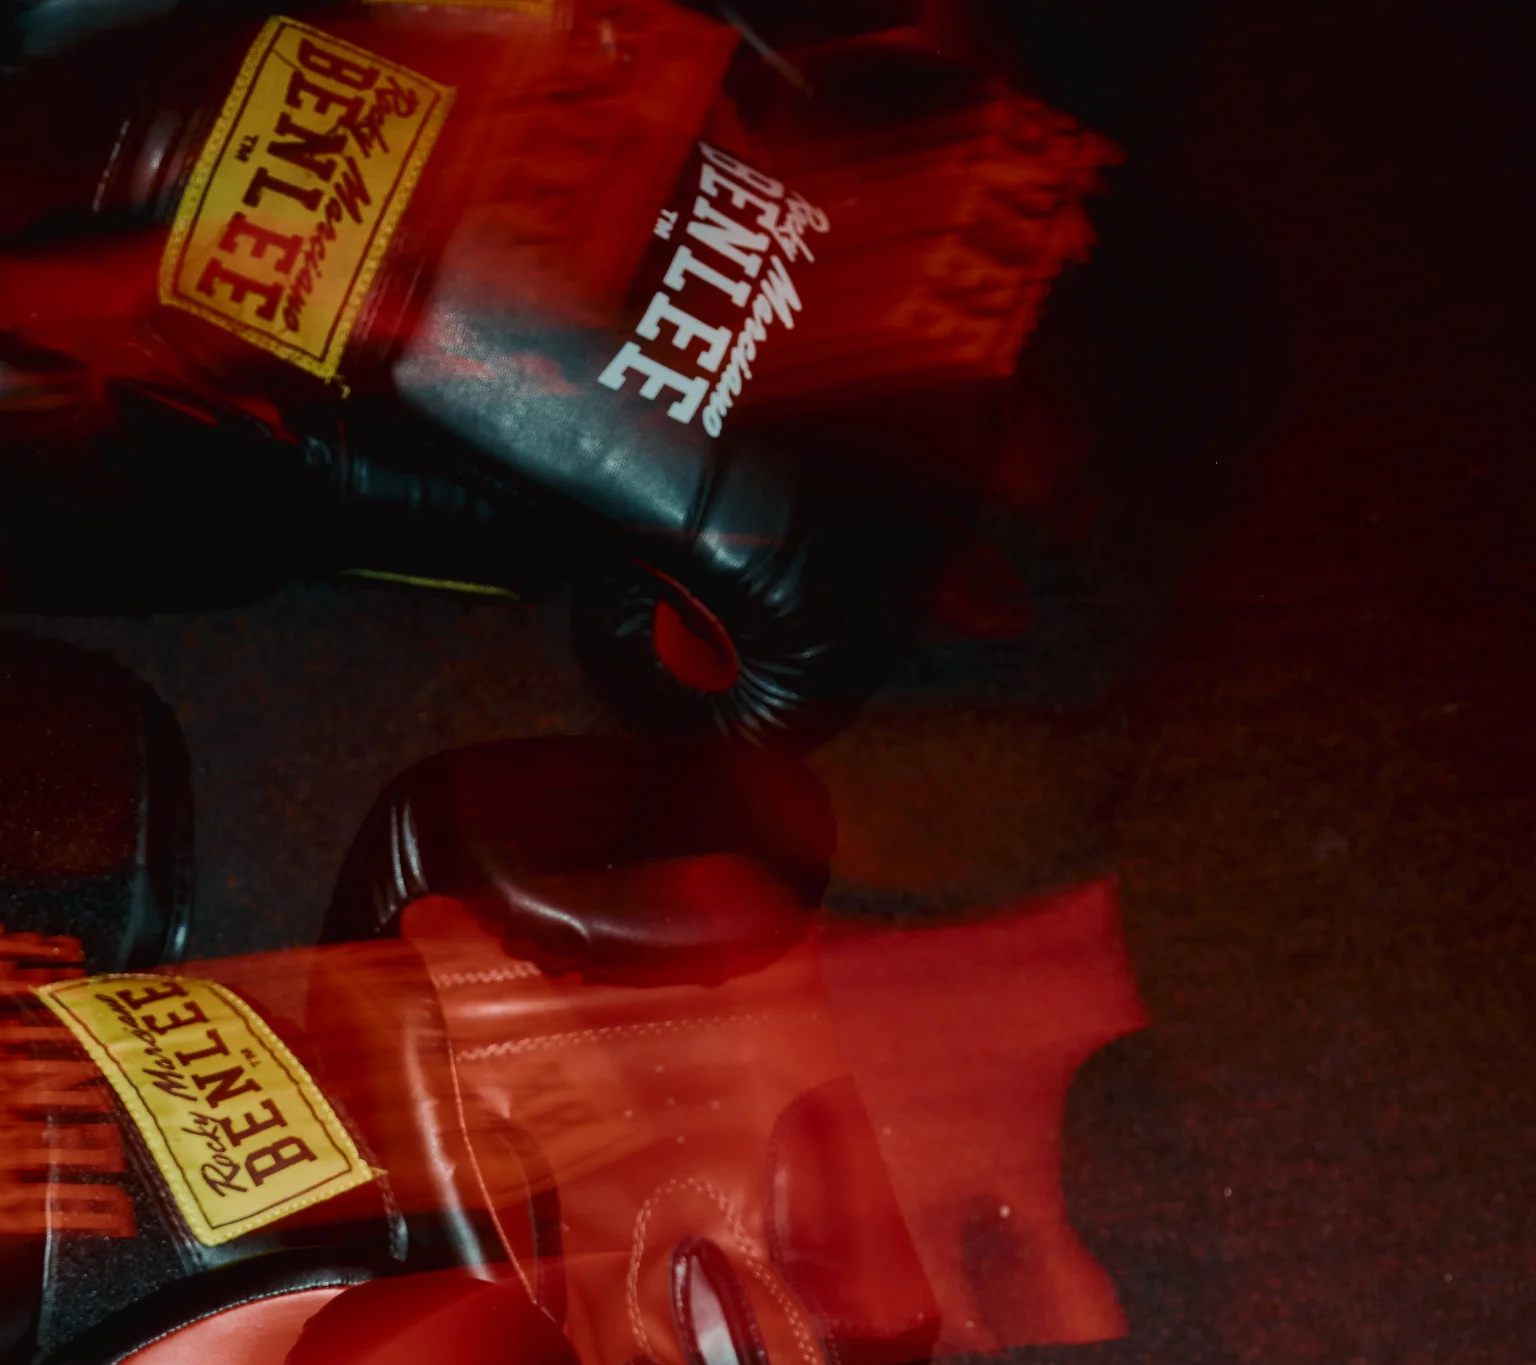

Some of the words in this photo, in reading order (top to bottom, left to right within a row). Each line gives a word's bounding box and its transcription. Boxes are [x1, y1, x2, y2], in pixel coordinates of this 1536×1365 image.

[195, 37, 381, 325] BENLEE
[597, 140, 786, 425] BENLEE
[115, 981, 319, 1188] BENLEE
[180, 1110, 249, 1197] Rocky
